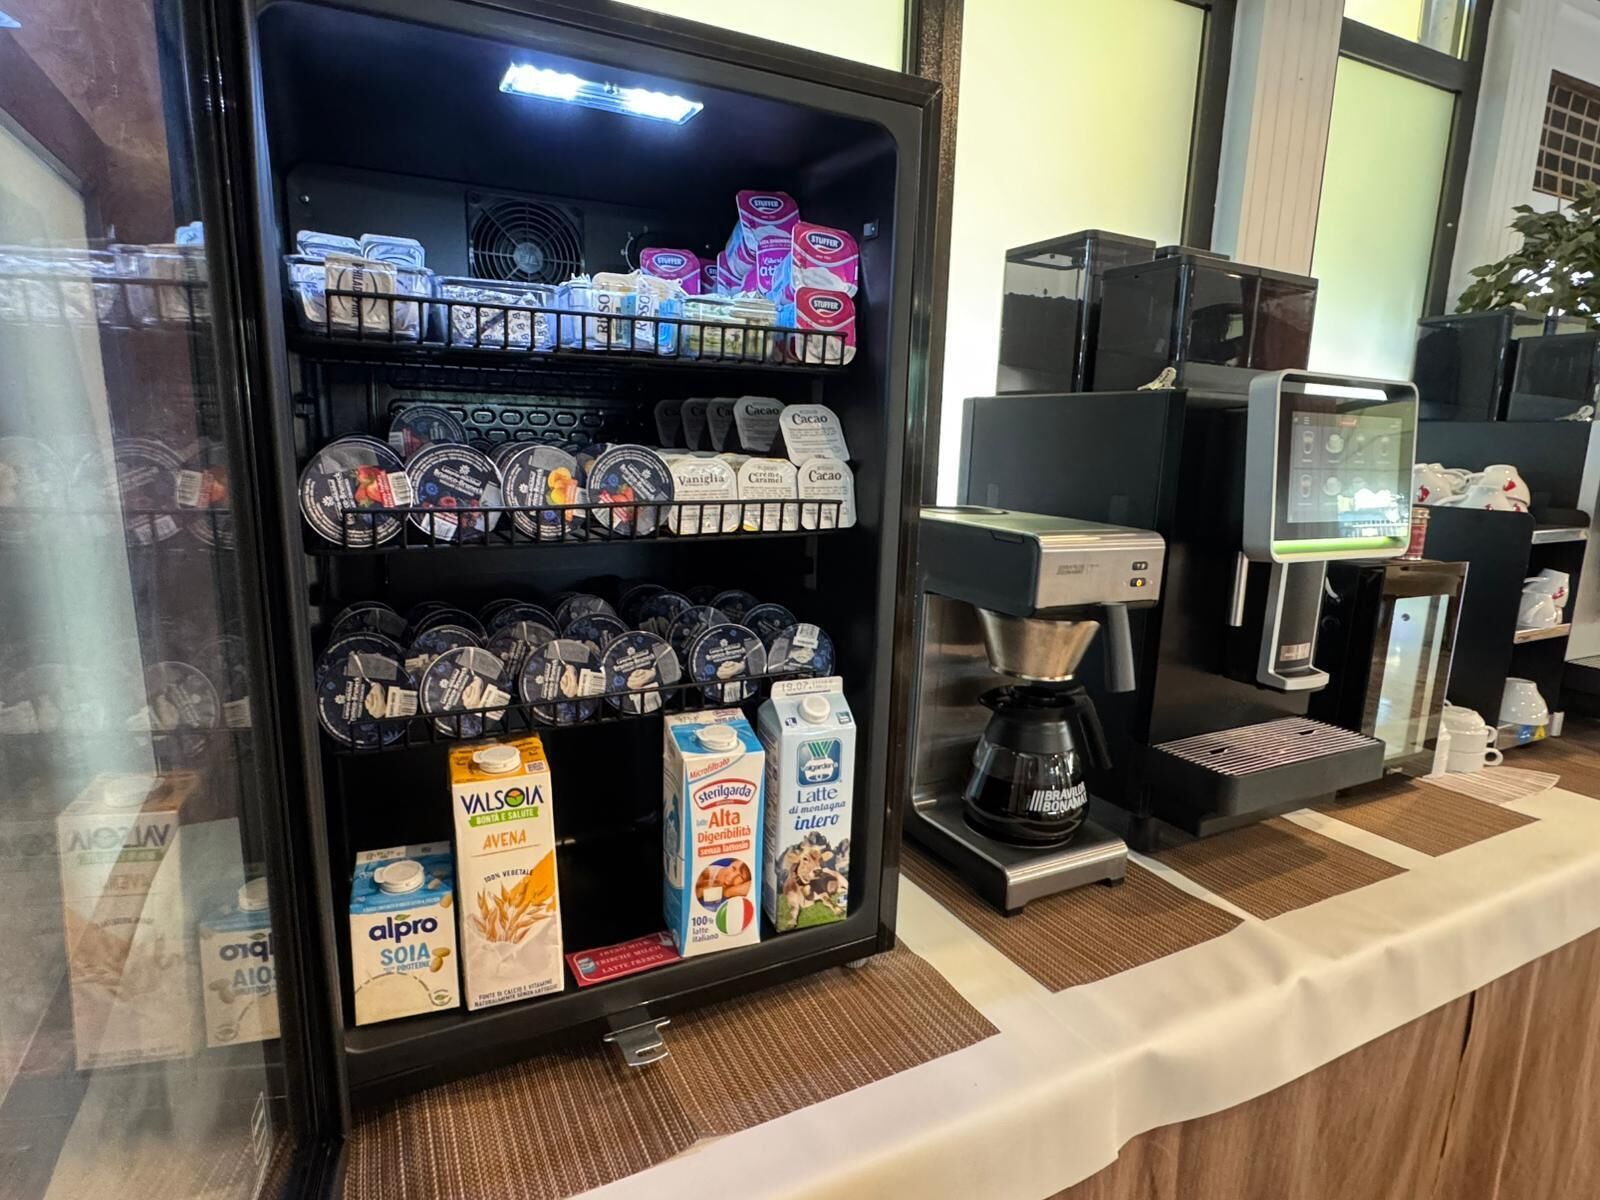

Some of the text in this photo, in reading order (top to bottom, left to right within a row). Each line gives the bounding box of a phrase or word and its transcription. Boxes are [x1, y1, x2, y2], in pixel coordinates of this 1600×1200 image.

[754, 199, 779, 208] STUFFER
[810, 235, 839, 249] STUFFER
[656, 256, 683, 266] STUFFER
[813, 299, 839, 311] STUFFER
[745, 404, 779, 418] Cacao
[792, 413, 828, 426] Cacao
[677, 472, 726, 487] Vaniglia
[808, 469, 842, 483] Cacao
[689, 757, 731, 778] Microfiltrato
[460, 784, 545, 815] VALSOIA
[698, 784, 752, 804] sterilgarda
[797, 787, 838, 804] Latte
[507, 808, 535, 820] SALUTE
[788, 800, 846, 815] di montagna
[708, 808, 741, 829] Alta
[794, 813, 840, 832] intero
[483, 829, 527, 850] AVENA
[697, 825, 752, 844] Digeribilità
[368, 916, 439, 944] alpro
[692, 926, 710, 936] latte
[692, 933, 720, 944] italiano
[380, 942, 431, 966] SOIA
